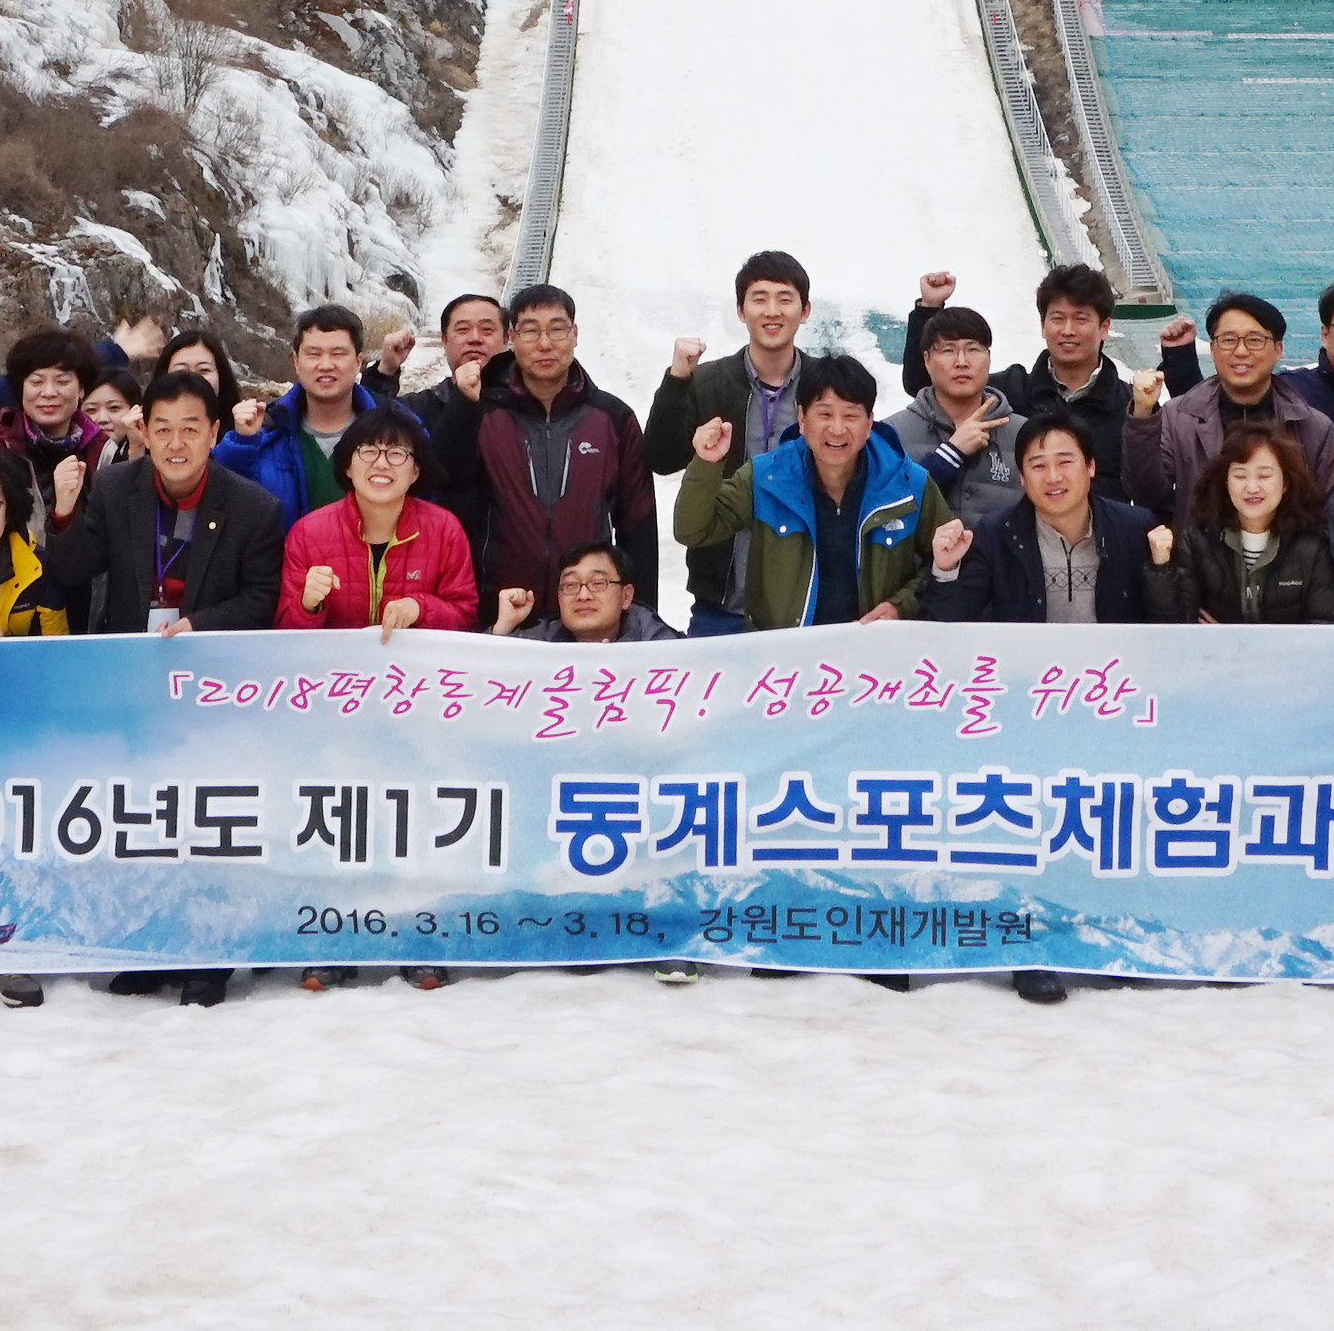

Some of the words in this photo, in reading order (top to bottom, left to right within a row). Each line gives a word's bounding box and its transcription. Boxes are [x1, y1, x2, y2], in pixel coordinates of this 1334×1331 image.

[988, 451, 1011, 483] LA
[746, 655, 1005, 735] 성공개최를
[297, 785, 503, 867] 제1기
[297, 905, 399, 938] 2016.
[699, 904, 1032, 948] 강원도인재개발원
